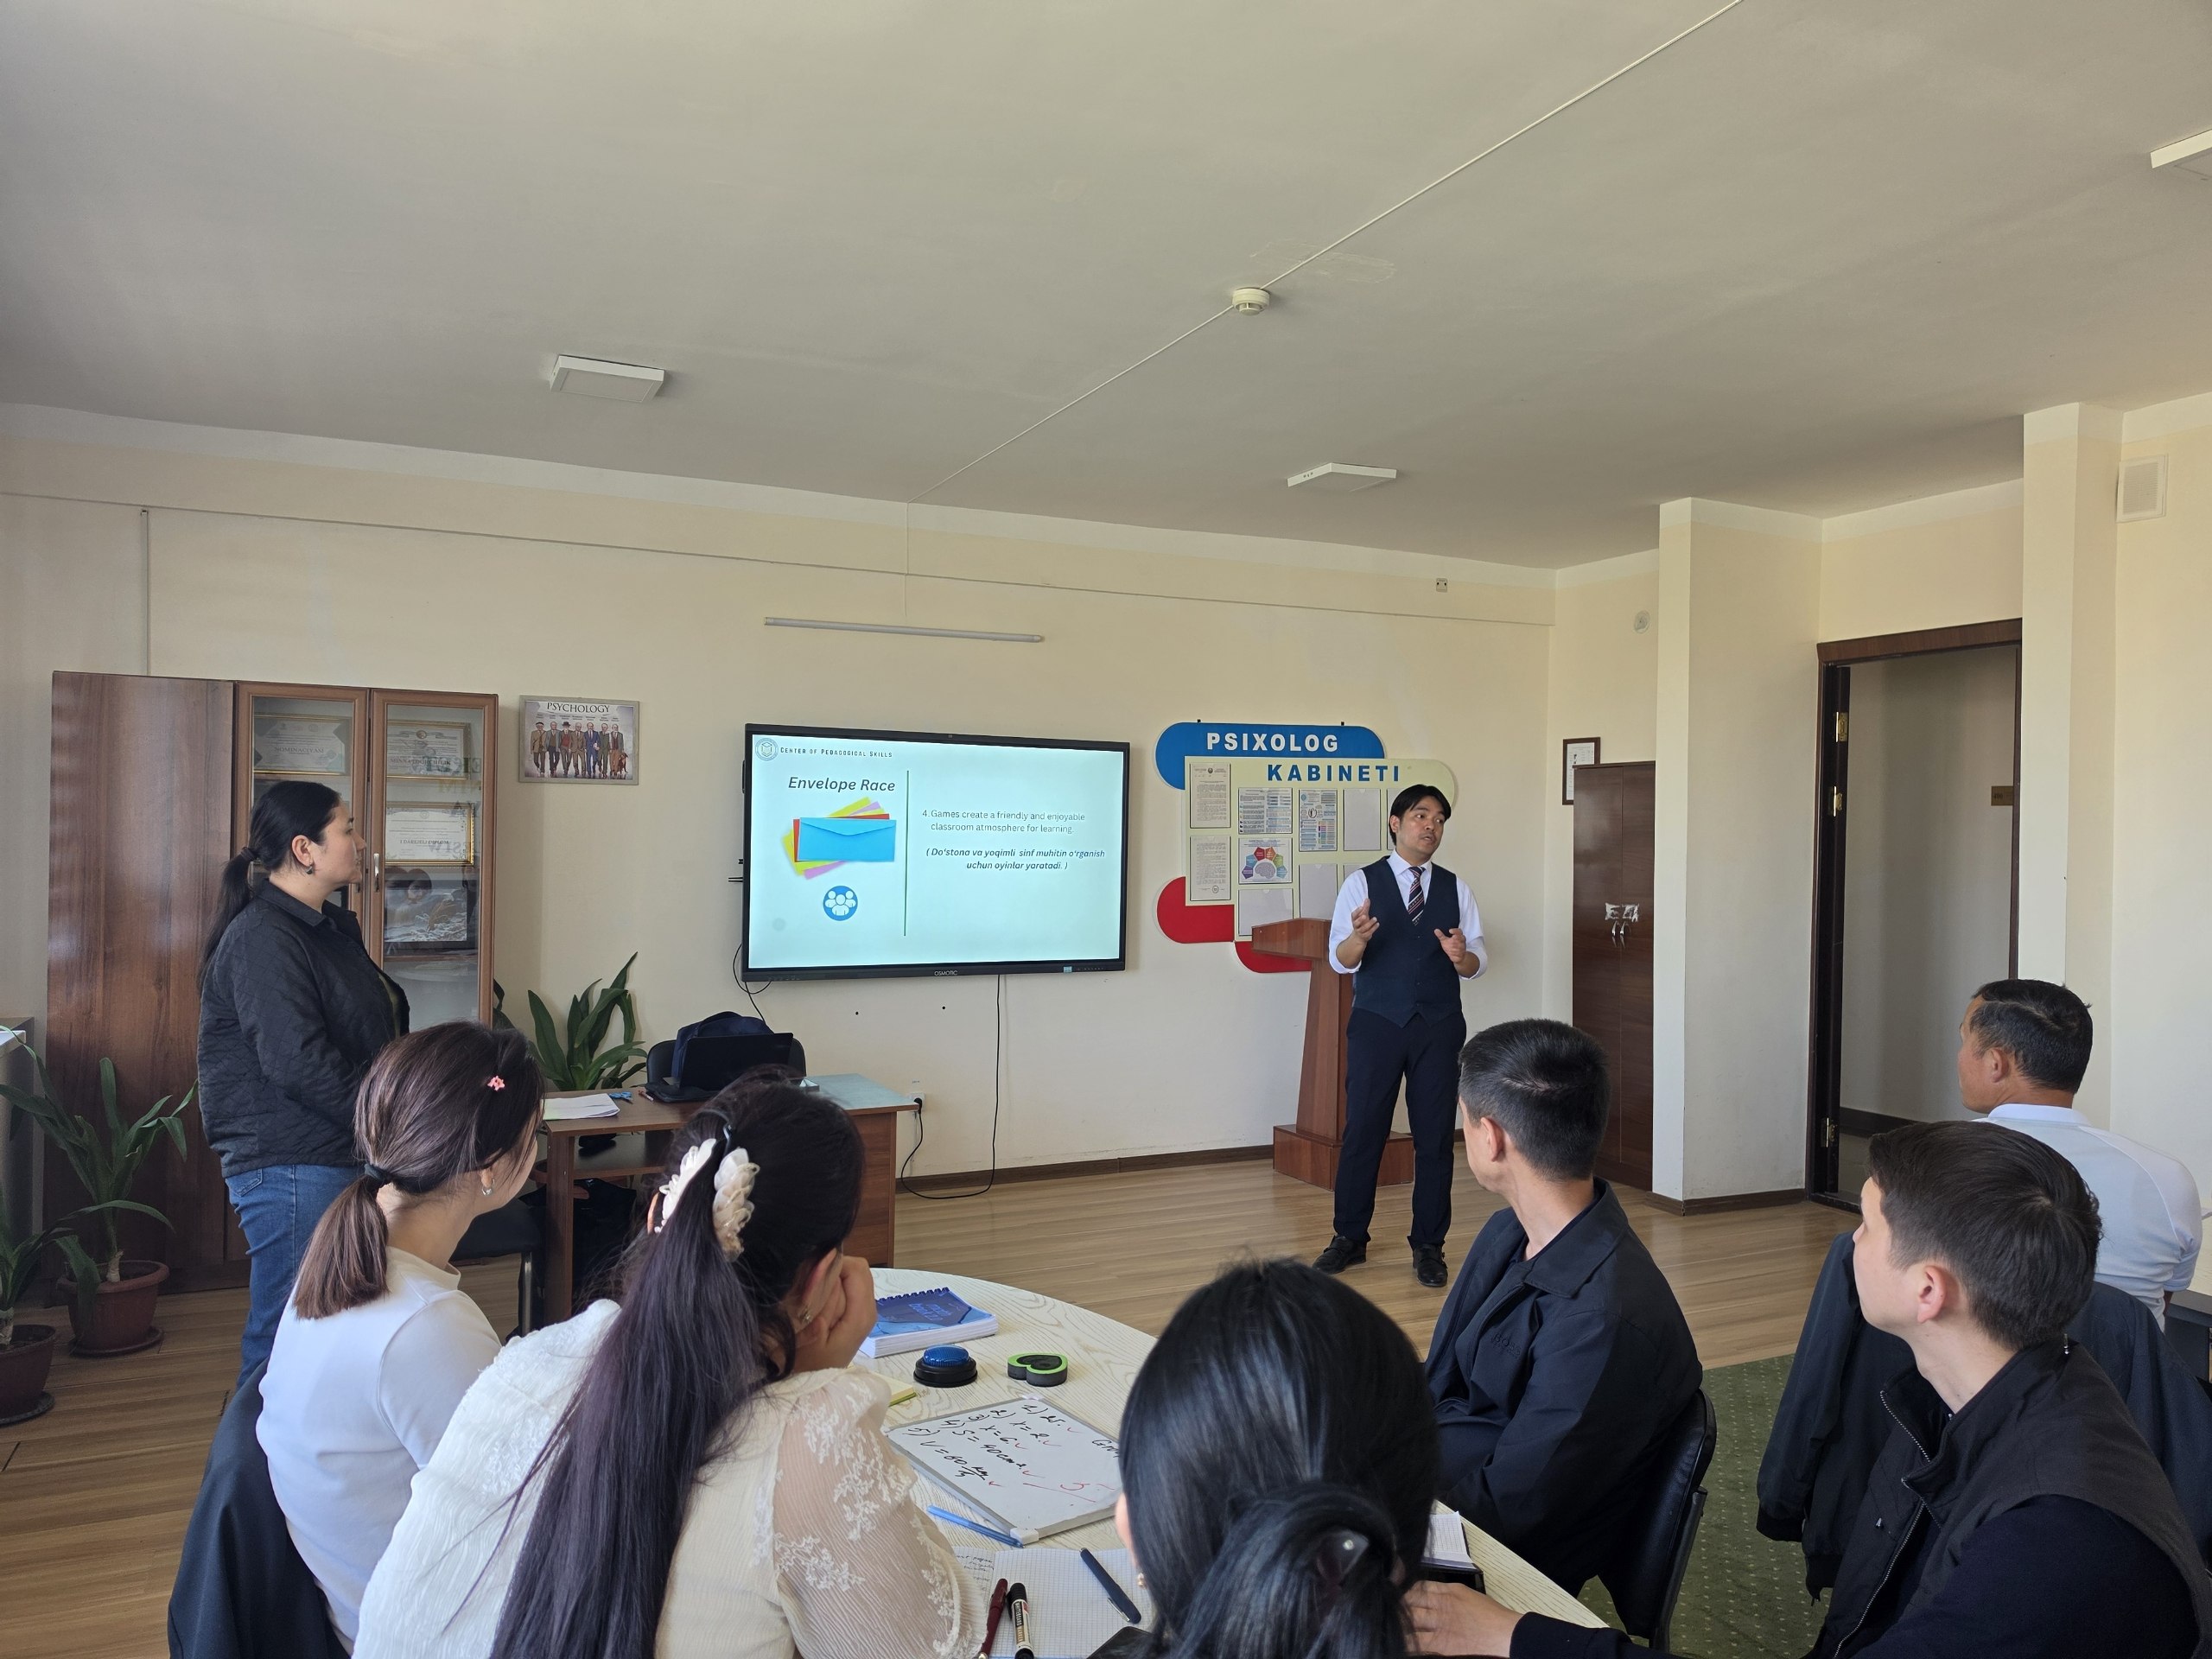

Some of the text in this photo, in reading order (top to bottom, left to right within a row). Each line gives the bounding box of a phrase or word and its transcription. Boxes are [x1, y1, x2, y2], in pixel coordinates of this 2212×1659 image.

[547, 702, 610, 713] PSYCHOLOGY
[1206, 733, 1338, 753] PSIXOLOG
[1268, 764, 1399, 782] KABINETI
[788, 776, 895, 792] Envelope Race
[931, 810, 960, 818] Games
[997, 810, 1029, 821] friendly
[1047, 813, 1085, 822] enjoyable
[931, 822, 974, 831] classroom
[976, 823, 1025, 833] atmosphere
[1040, 824, 1075, 834] learning.
[983, 849, 1016, 858] yoqimli
[1019, 849, 1035, 857] sinf
[995, 861, 1024, 871] oyinlar
